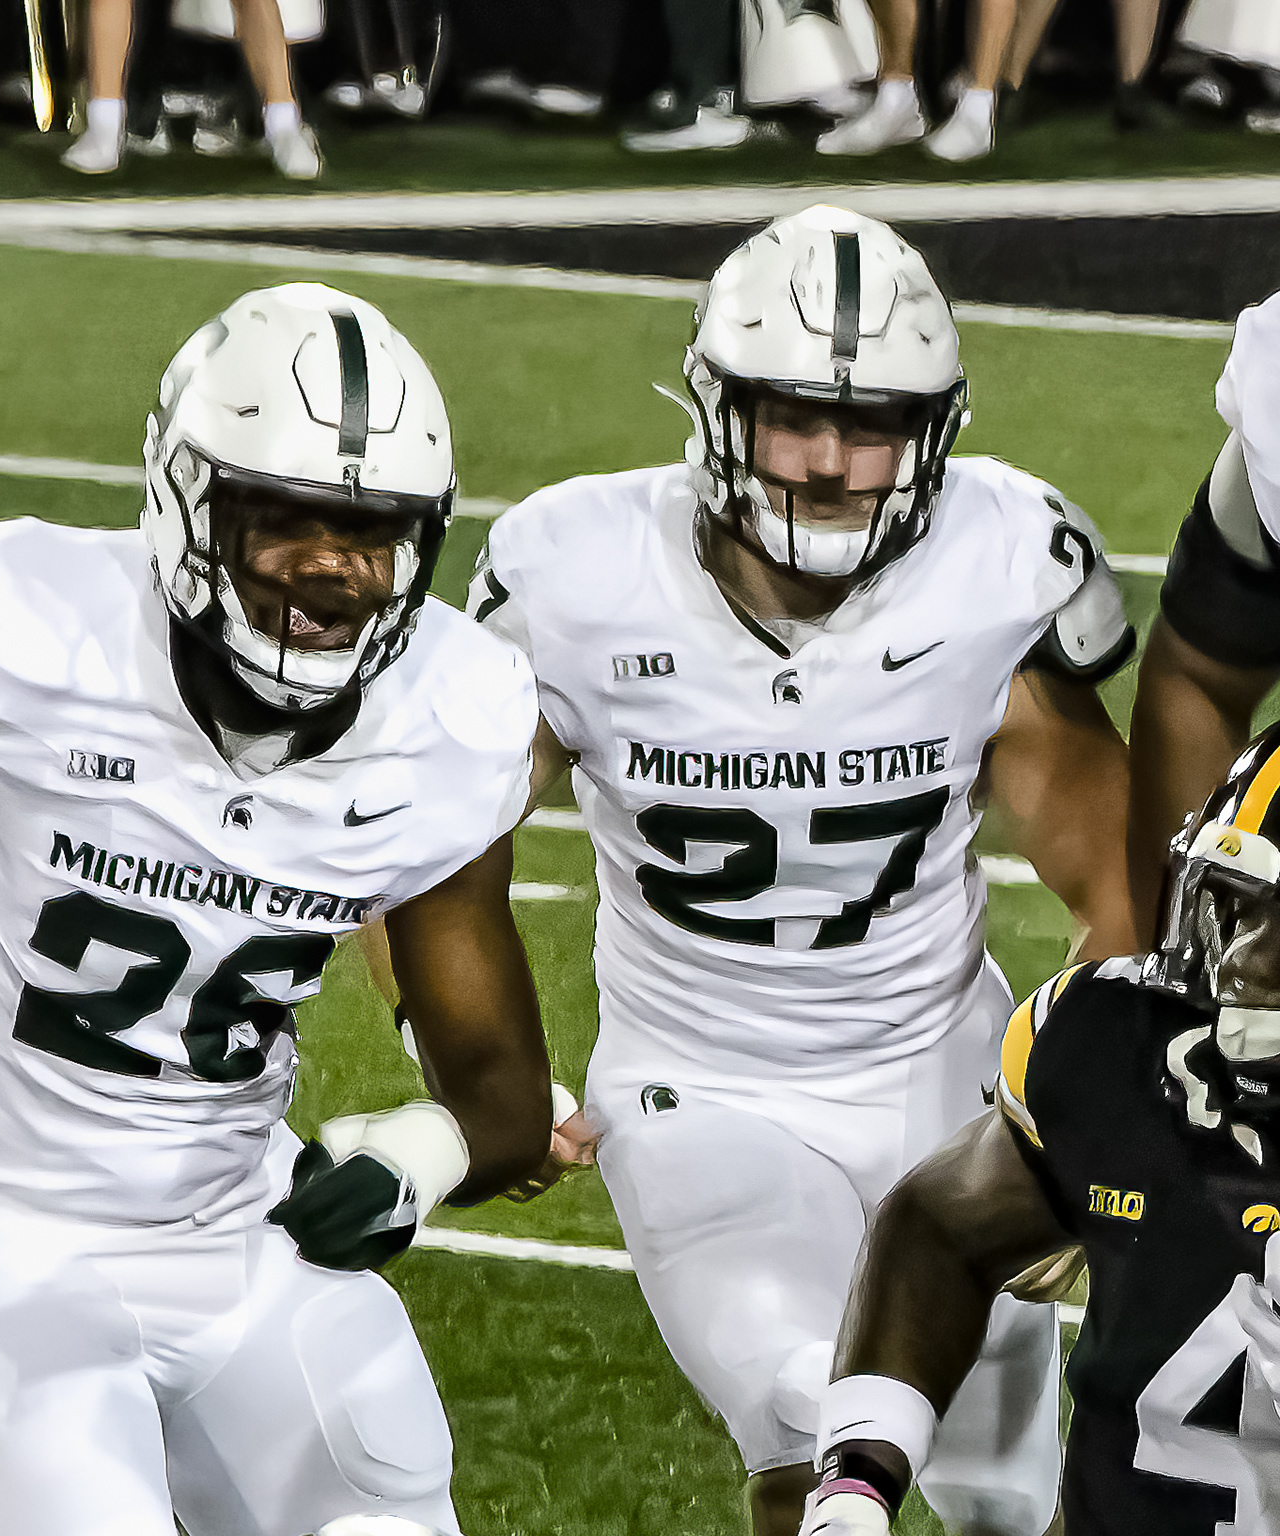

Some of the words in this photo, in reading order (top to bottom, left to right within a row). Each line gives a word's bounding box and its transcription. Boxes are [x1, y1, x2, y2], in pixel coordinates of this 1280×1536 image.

[626, 740, 827, 791] MICHIGAN
[838, 736, 951, 787] STATE
[48, 829, 264, 918] MICHIGAN
[634, 784, 953, 950] 27
[11, 889, 337, 1083] 26
